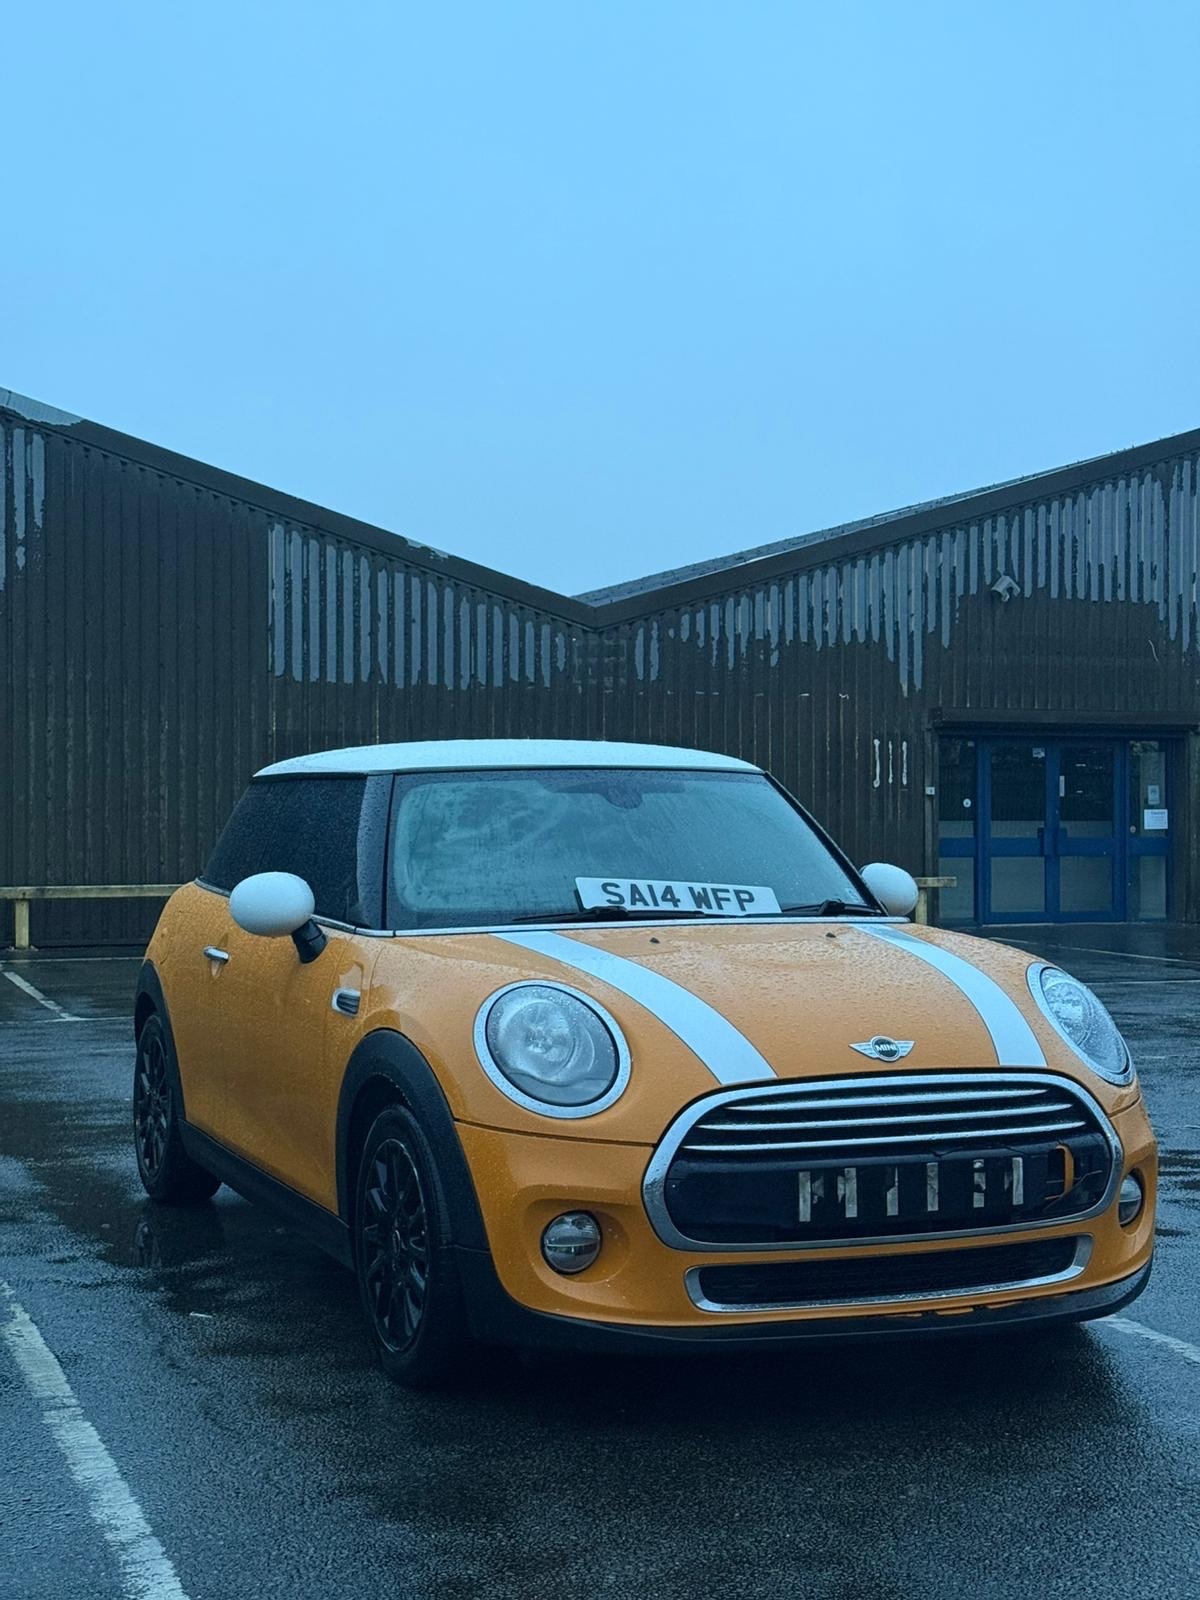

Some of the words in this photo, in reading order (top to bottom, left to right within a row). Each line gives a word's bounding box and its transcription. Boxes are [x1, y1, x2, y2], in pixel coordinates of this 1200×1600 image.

[601, 882, 680, 908] SA14
[688, 886, 755, 911] WFP
[874, 1043, 897, 1052] MINI
